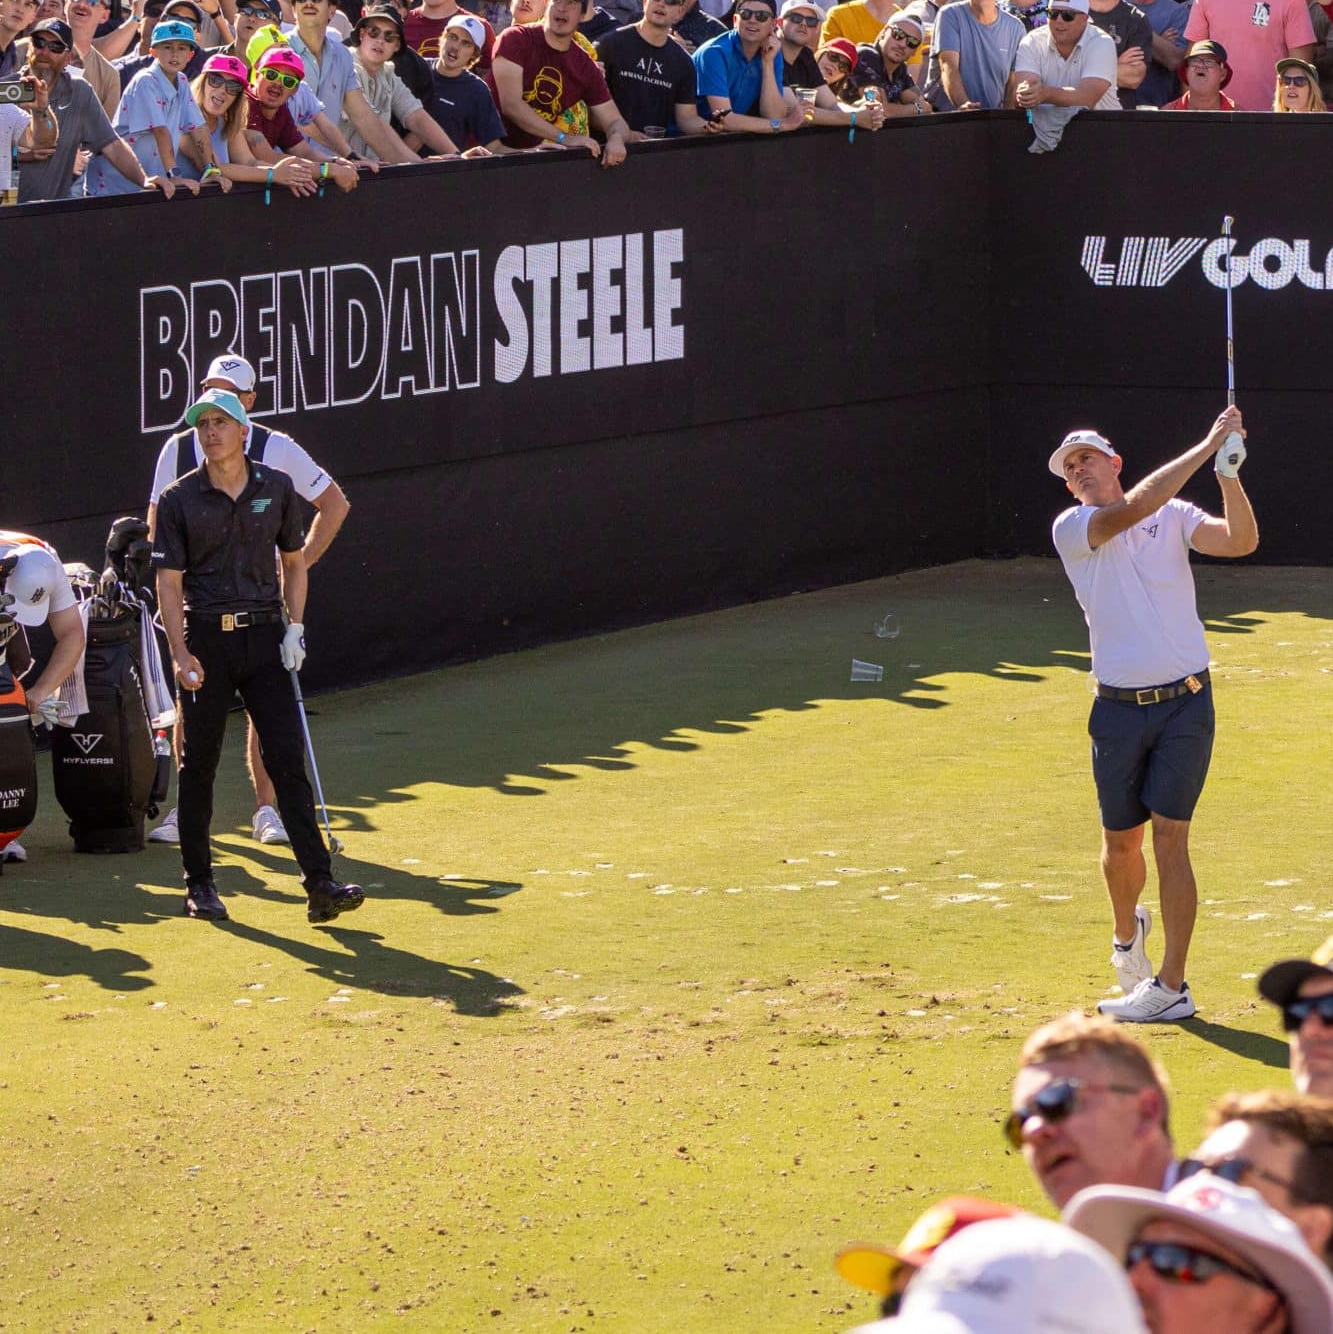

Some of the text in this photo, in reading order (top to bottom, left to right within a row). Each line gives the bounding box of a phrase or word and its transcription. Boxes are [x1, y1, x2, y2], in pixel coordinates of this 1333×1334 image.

[619, 70, 673, 89] ARMANI EXCHANGE
[1081, 235, 1208, 287] LIV
[140, 228, 685, 434] BRENDAN STEELE
[62, 757, 109, 765] HYFLYERS
[2, 798, 21, 809] LEE
